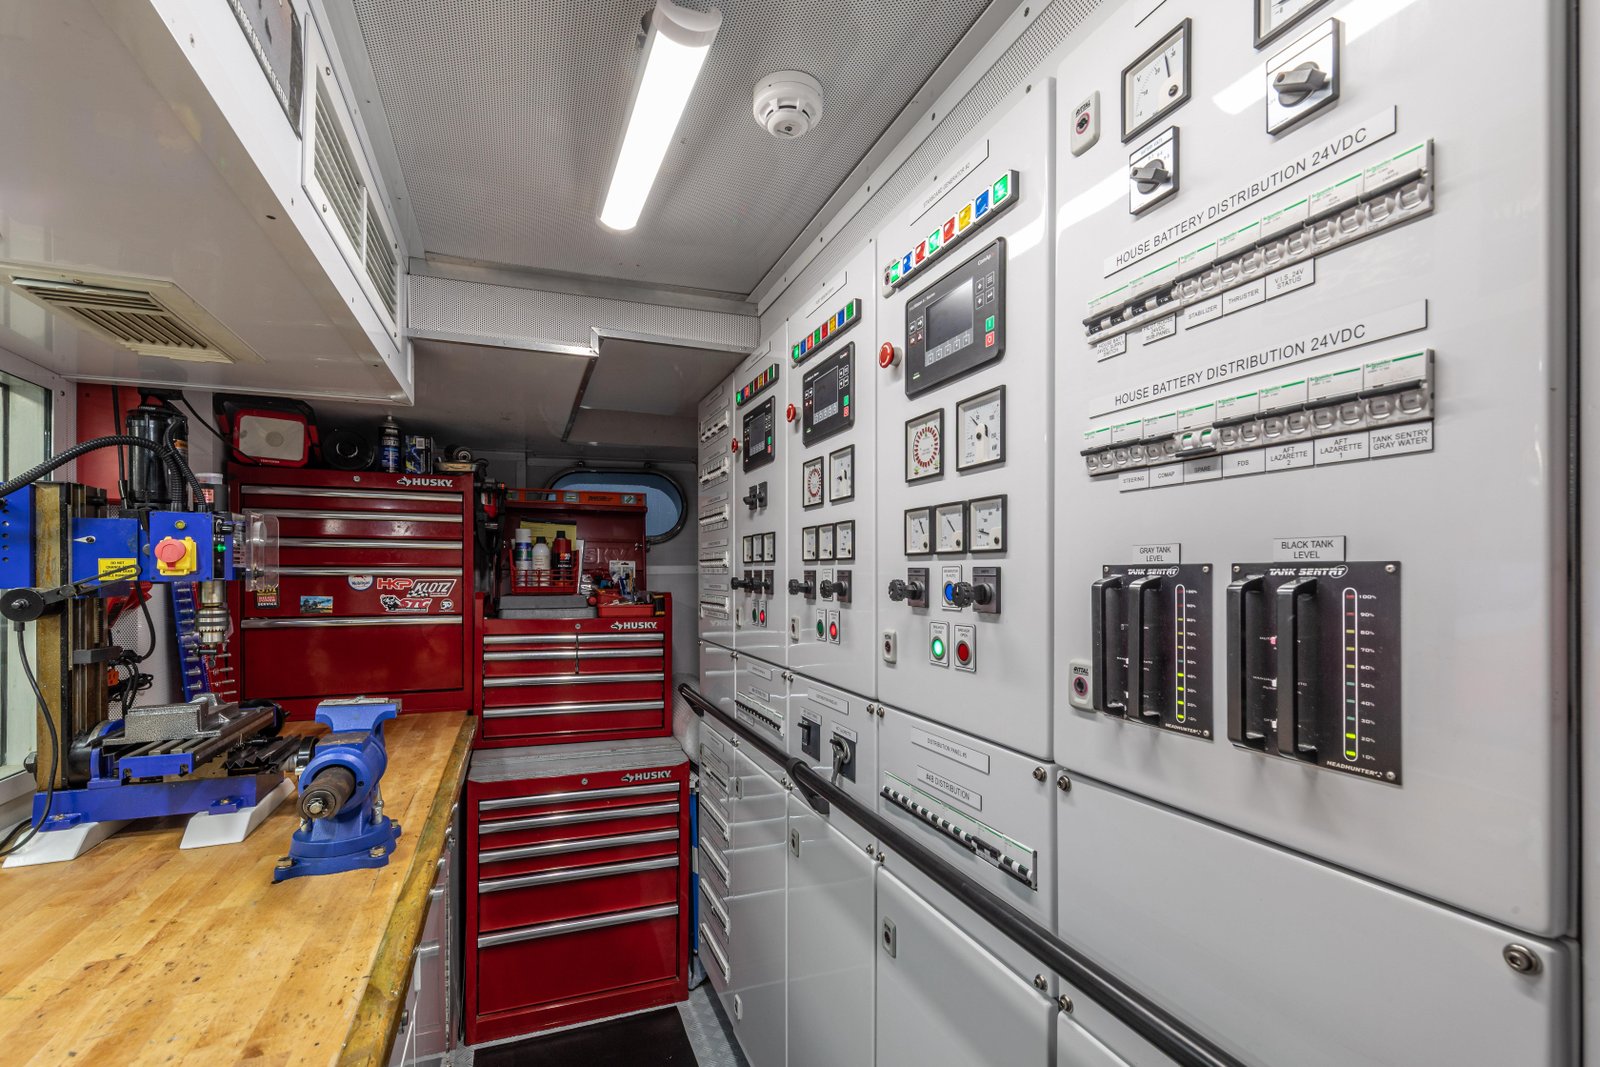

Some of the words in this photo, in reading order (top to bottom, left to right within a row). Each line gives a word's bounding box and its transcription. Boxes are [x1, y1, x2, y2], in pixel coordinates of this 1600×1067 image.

[1116, 240, 1151, 266] HOUSE
[1153, 212, 1205, 247] BATTERY
[1208, 158, 1306, 220] DISTRIBUTION
[1312, 128, 1367, 166] 24VDC
[1277, 278, 1302, 290] STATUS
[1228, 288, 1260, 304] THRUSTER
[1188, 304, 1218, 320] STABILIZER
[1114, 386, 1149, 406] HOUSE
[1152, 370, 1203, 396] BATTERY
[1206, 341, 1305, 380] DISTRIBUTION
[1310, 324, 1366, 351] 24VDC
[1372, 434, 1392, 443] TANK
[1394, 429, 1430, 440] SENTRY
[1320, 442, 1362, 454] LAZARETTE
[1373, 442, 1396, 451] GRAY
[1398, 436, 1428, 448] WATER
[1270, 450, 1308, 461] LAZARETTE
[1282, 446, 1296, 454] AFT
[412, 478, 453, 488] HUSKY
[1122, 475, 1144, 484] STEERING
[1282, 540, 1310, 550] BLACK
[1311, 540, 1334, 548] TANK
[1294, 551, 1320, 560] LEVEL
[1127, 568, 1146, 576] TANK
[1147, 568, 1178, 576] SENTRY
[1269, 568, 1296, 576] TANK
[1298, 568, 1346, 576] SENTRY
[414, 582, 452, 593] KLOTZ
[623, 622, 658, 630] HUSKY
[1165, 723, 1198, 734] HEADHUNTER
[1326, 760, 1376, 776] HEADHUNTER
[634, 770, 672, 782] HUSKY
[934, 776, 970, 800] DISTRIBUTION
